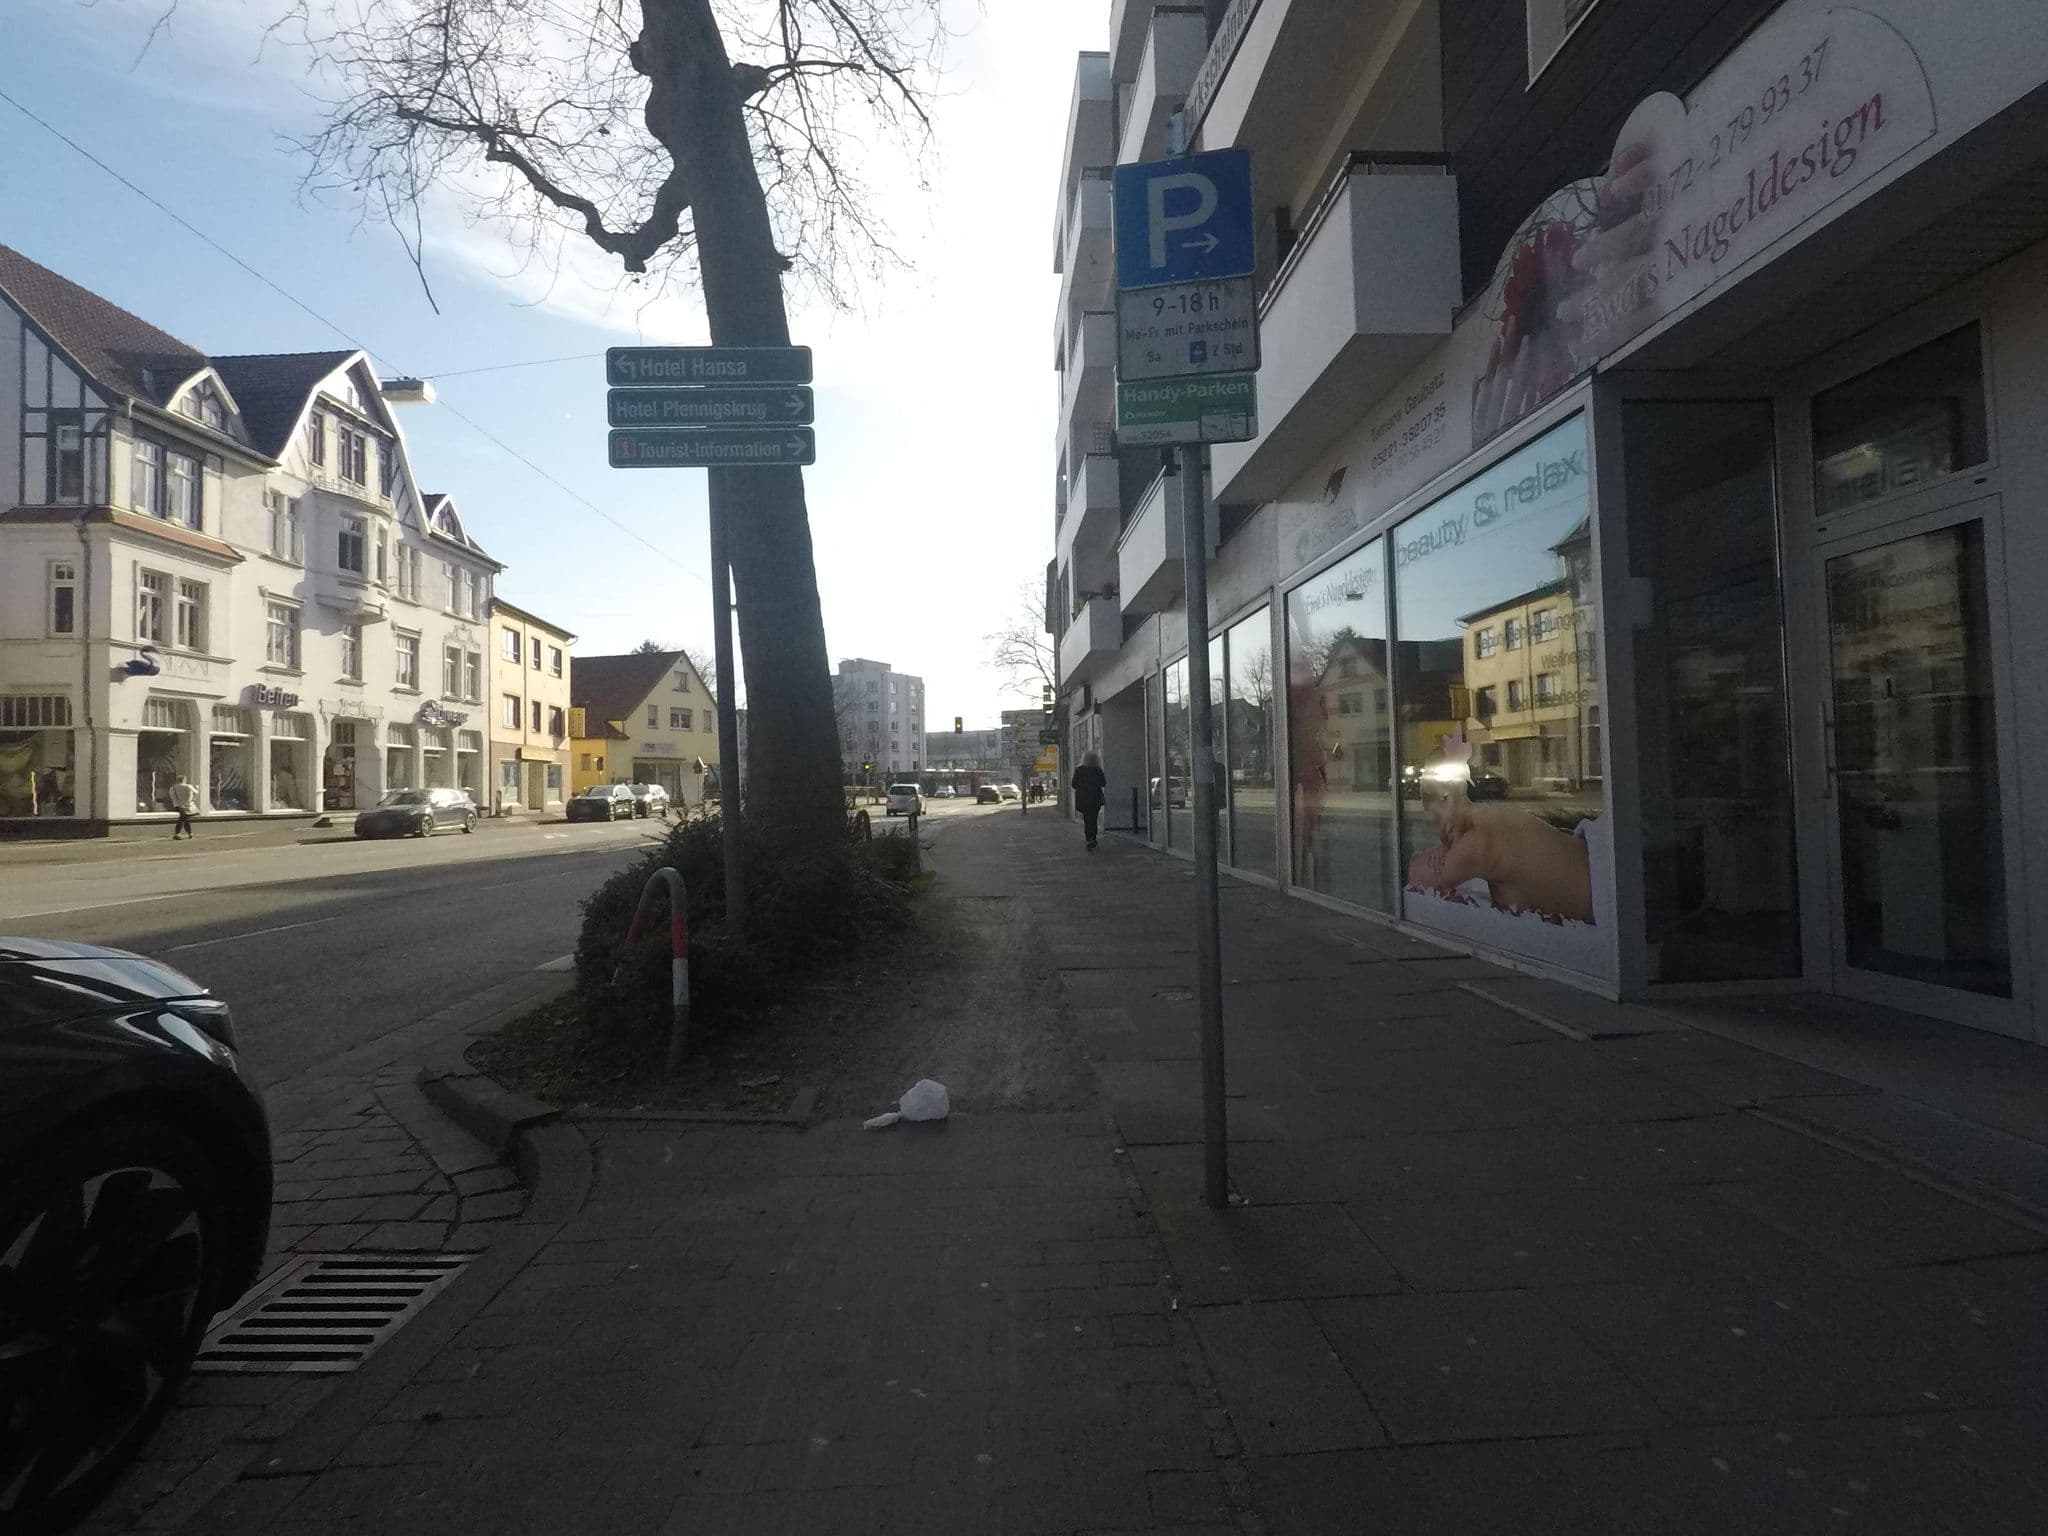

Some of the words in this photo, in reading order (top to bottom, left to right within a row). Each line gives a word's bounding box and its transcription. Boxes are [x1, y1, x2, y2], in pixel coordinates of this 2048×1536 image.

[1663, 92, 1885, 282] Nageldesign
[1147, 172, 1218, 269] P
[1152, 292, 1203, 317] 9-18
[1208, 291, 1220, 311] h
[1165, 324, 1183, 337] mit
[1187, 317, 1249, 335] Parkschein
[640, 358, 686, 377] Hotel
[692, 358, 747, 377] Hansa
[1146, 351, 1161, 363] Sa
[1123, 380, 1249, 403] Handy-Parken
[616, 400, 658, 417] Hotel
[663, 400, 767, 420] Pfennigskrug
[1396, 513, 1467, 567] beauty
[1473, 491, 1499, 528] &
[1504, 450, 1582, 513] relax
